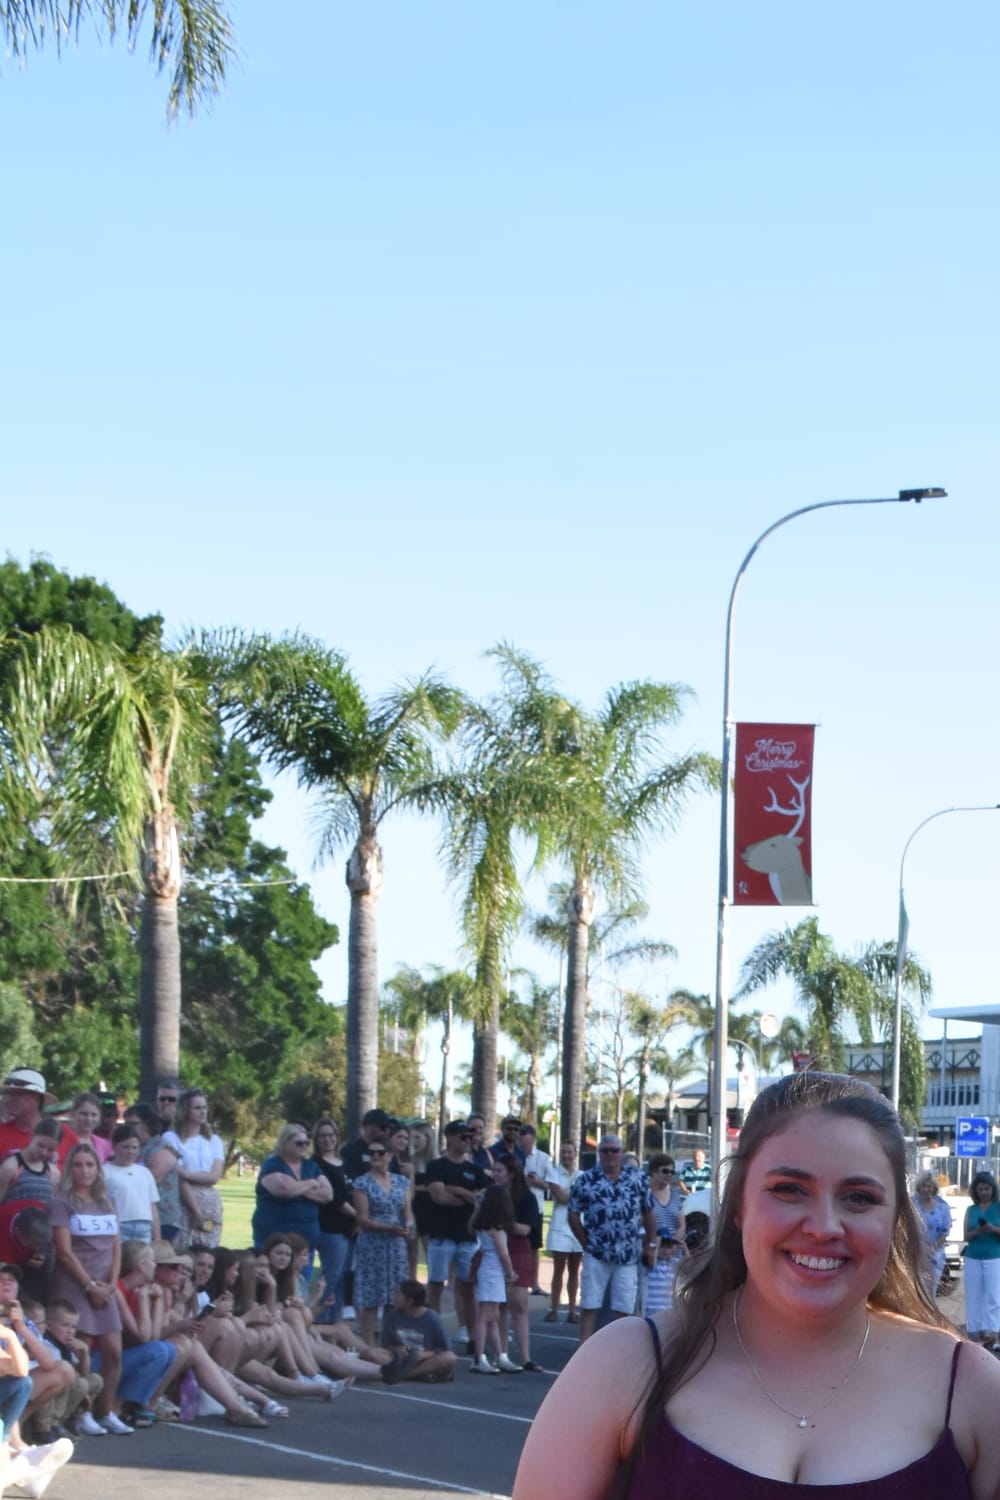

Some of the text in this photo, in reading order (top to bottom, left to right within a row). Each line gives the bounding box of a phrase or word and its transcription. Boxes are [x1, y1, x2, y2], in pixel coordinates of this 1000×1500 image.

[755, 738, 797, 760] Merry
[745, 752, 804, 772] Christmas
[960, 1122, 971, 1136] P
